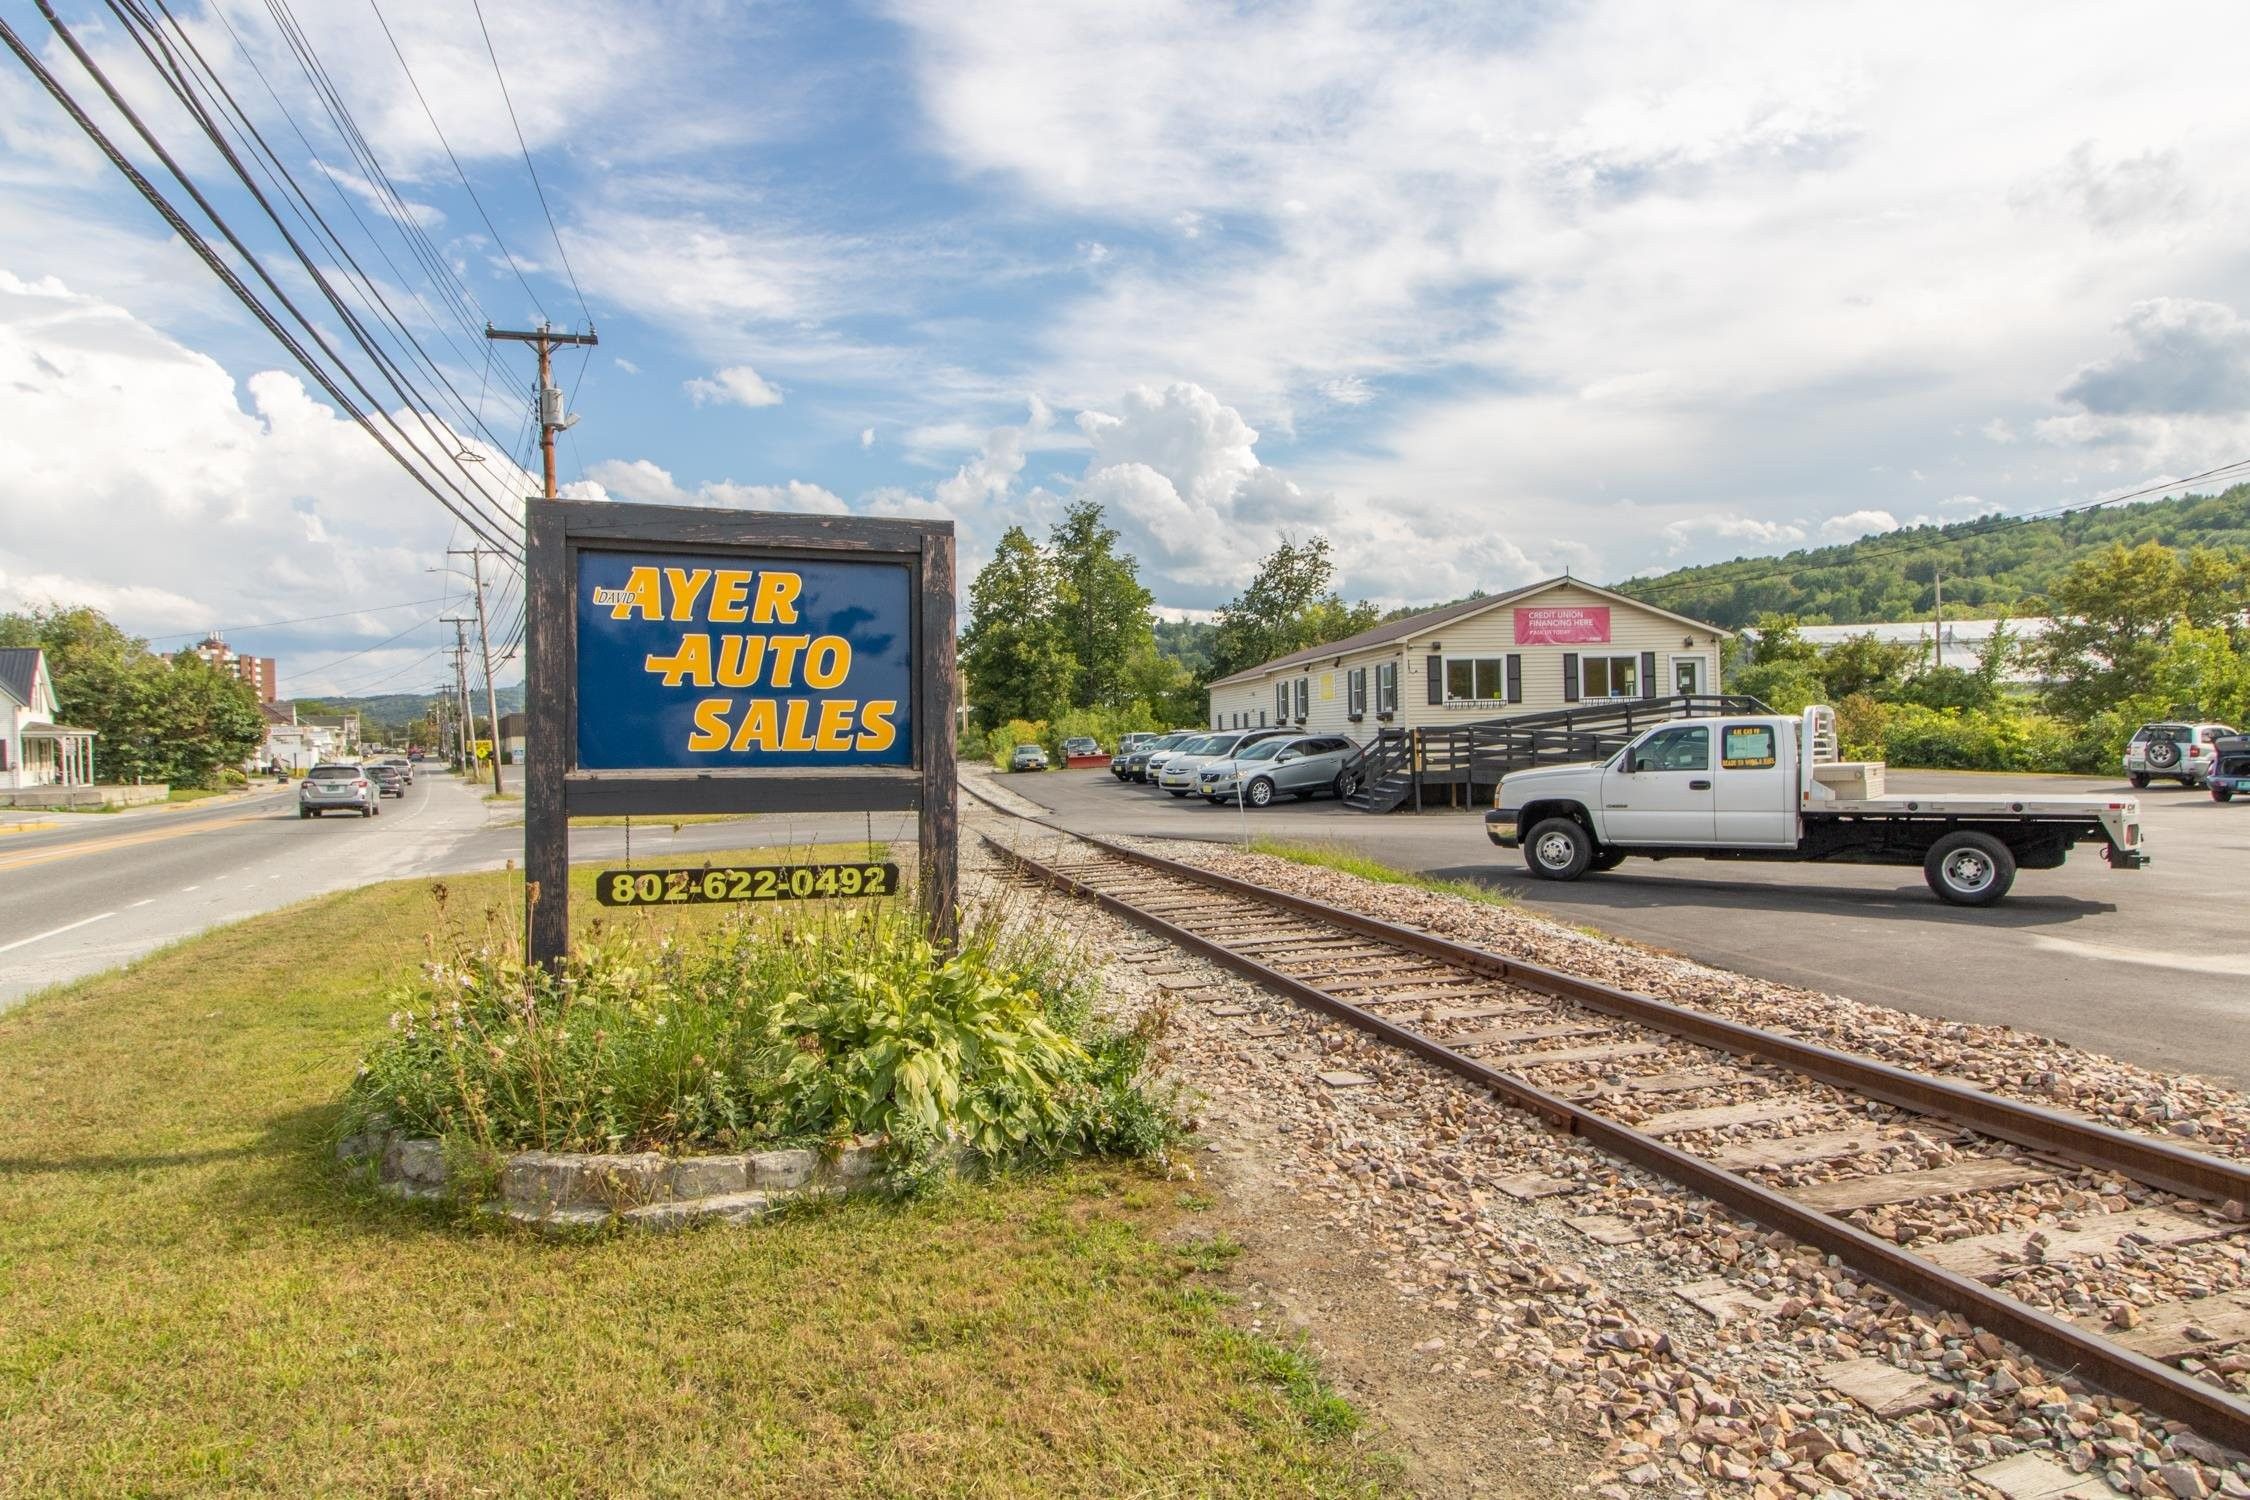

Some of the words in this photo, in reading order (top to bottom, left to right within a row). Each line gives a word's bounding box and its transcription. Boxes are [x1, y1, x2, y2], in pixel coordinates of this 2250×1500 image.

[593, 567, 803, 625] AYER
[599, 591, 636, 604] DAVID
[1529, 611, 1555, 619] CREDIT
[1557, 611, 1584, 619] UNION
[1529, 619, 1571, 627] FINANCING
[645, 633, 852, 690] AUTO
[688, 698, 898, 753] SALES
[611, 867, 886, 903] 802-622-0492
